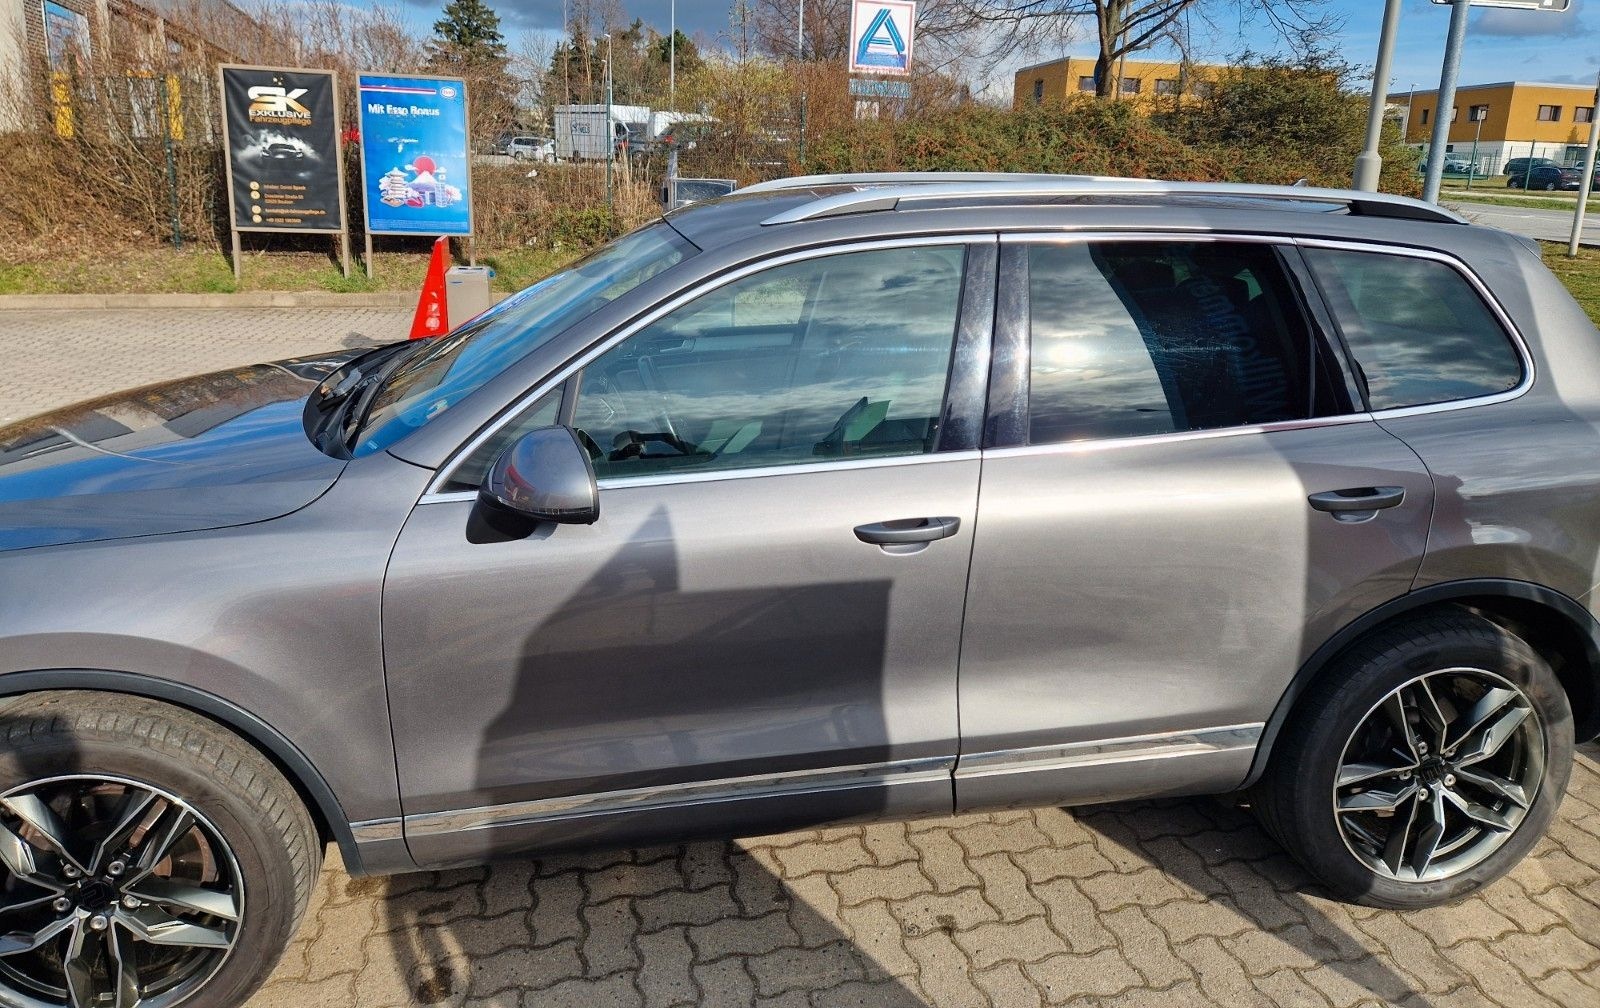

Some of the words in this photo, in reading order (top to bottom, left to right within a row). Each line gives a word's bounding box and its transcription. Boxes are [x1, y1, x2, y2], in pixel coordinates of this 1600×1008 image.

[249, 109, 312, 119] EXKLUSIVE
[368, 103, 385, 114] Mit
[410, 106, 440, 116] Bonus
